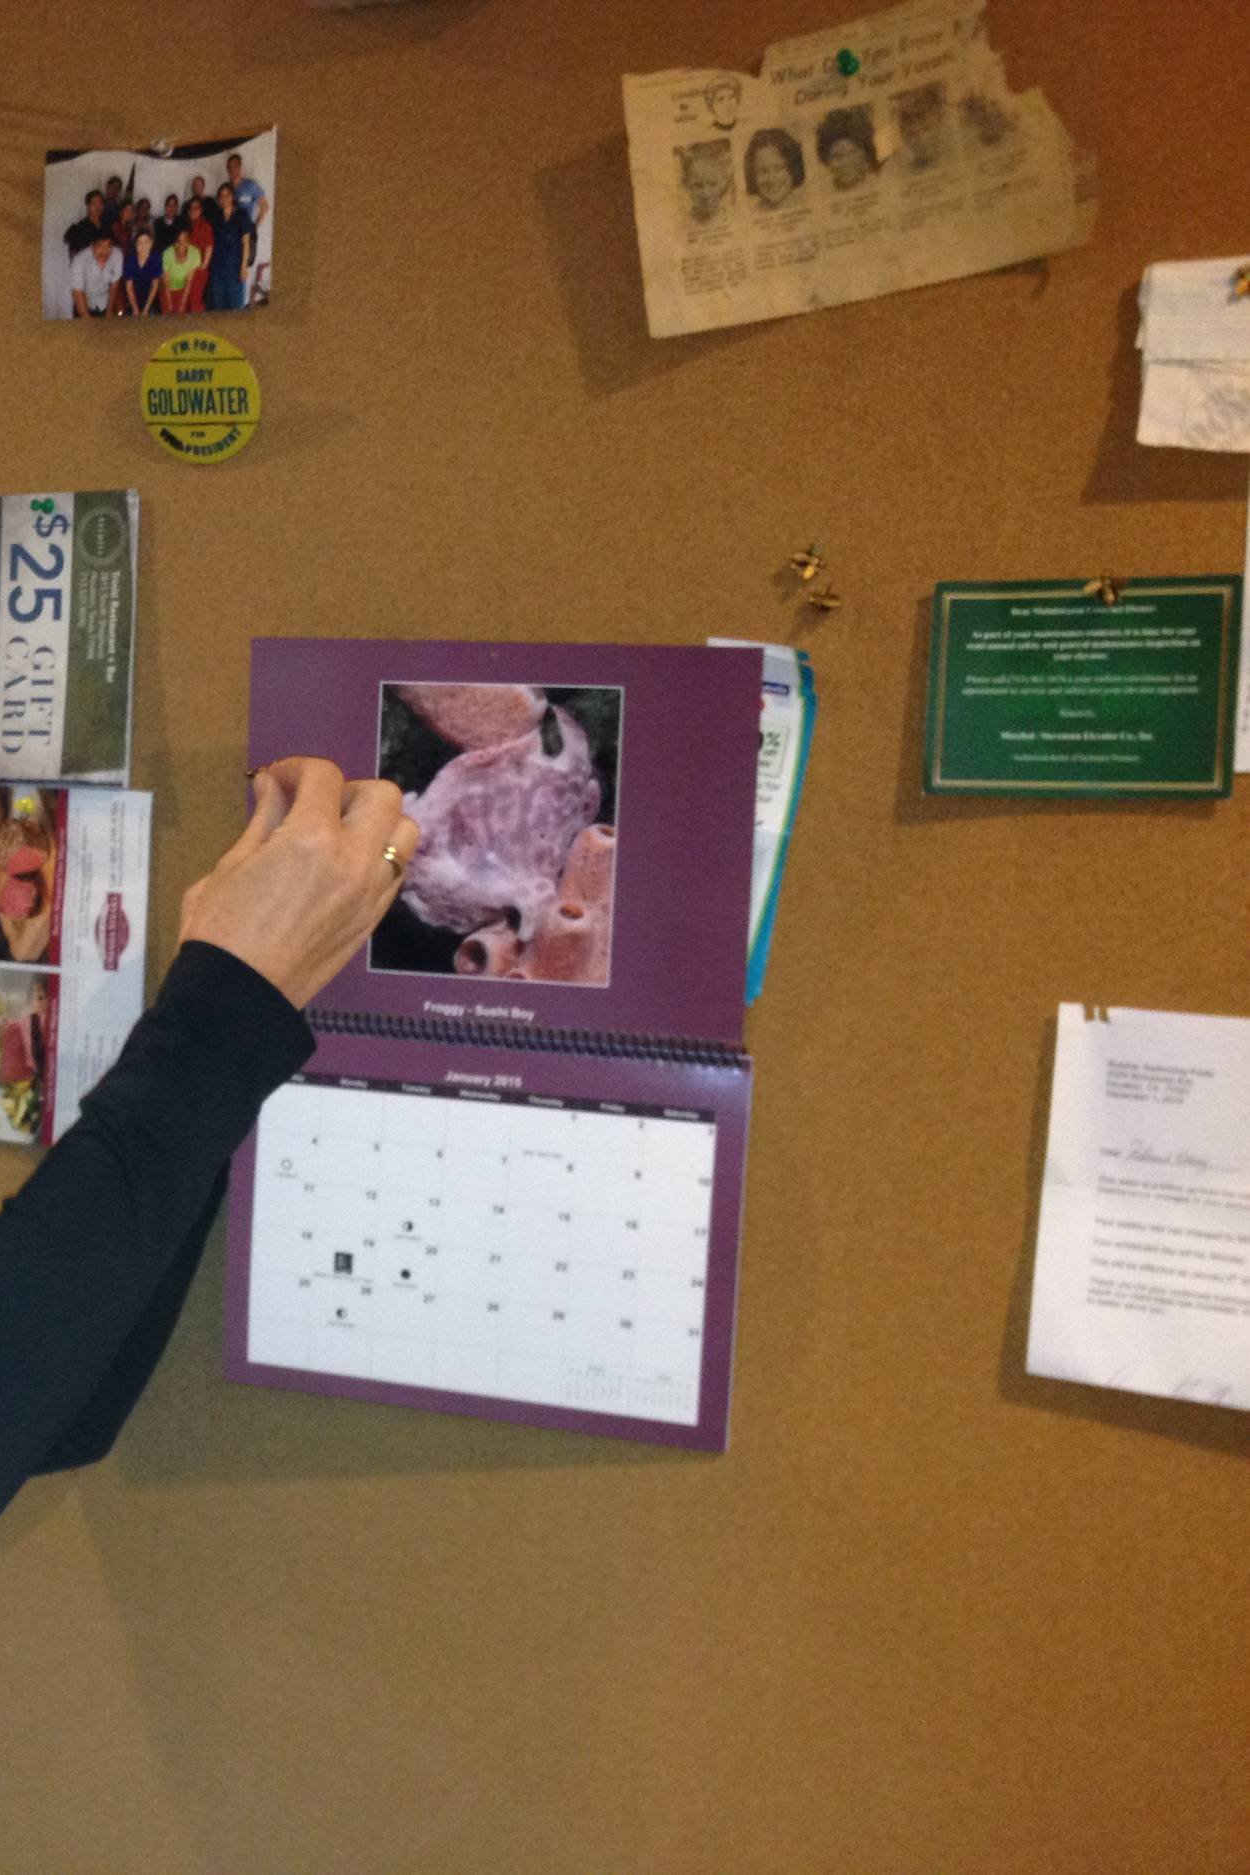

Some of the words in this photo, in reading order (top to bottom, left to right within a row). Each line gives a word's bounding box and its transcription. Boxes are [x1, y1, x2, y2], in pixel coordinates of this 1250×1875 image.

[176, 367, 214, 383] BARRY
[147, 386, 249, 417] GOLDWATER
[2, 636, 29, 754] CARD
[28, 646, 56, 747] GIFT
[424, 1000, 465, 1017] Froggy
[444, 1070, 492, 1087] January
